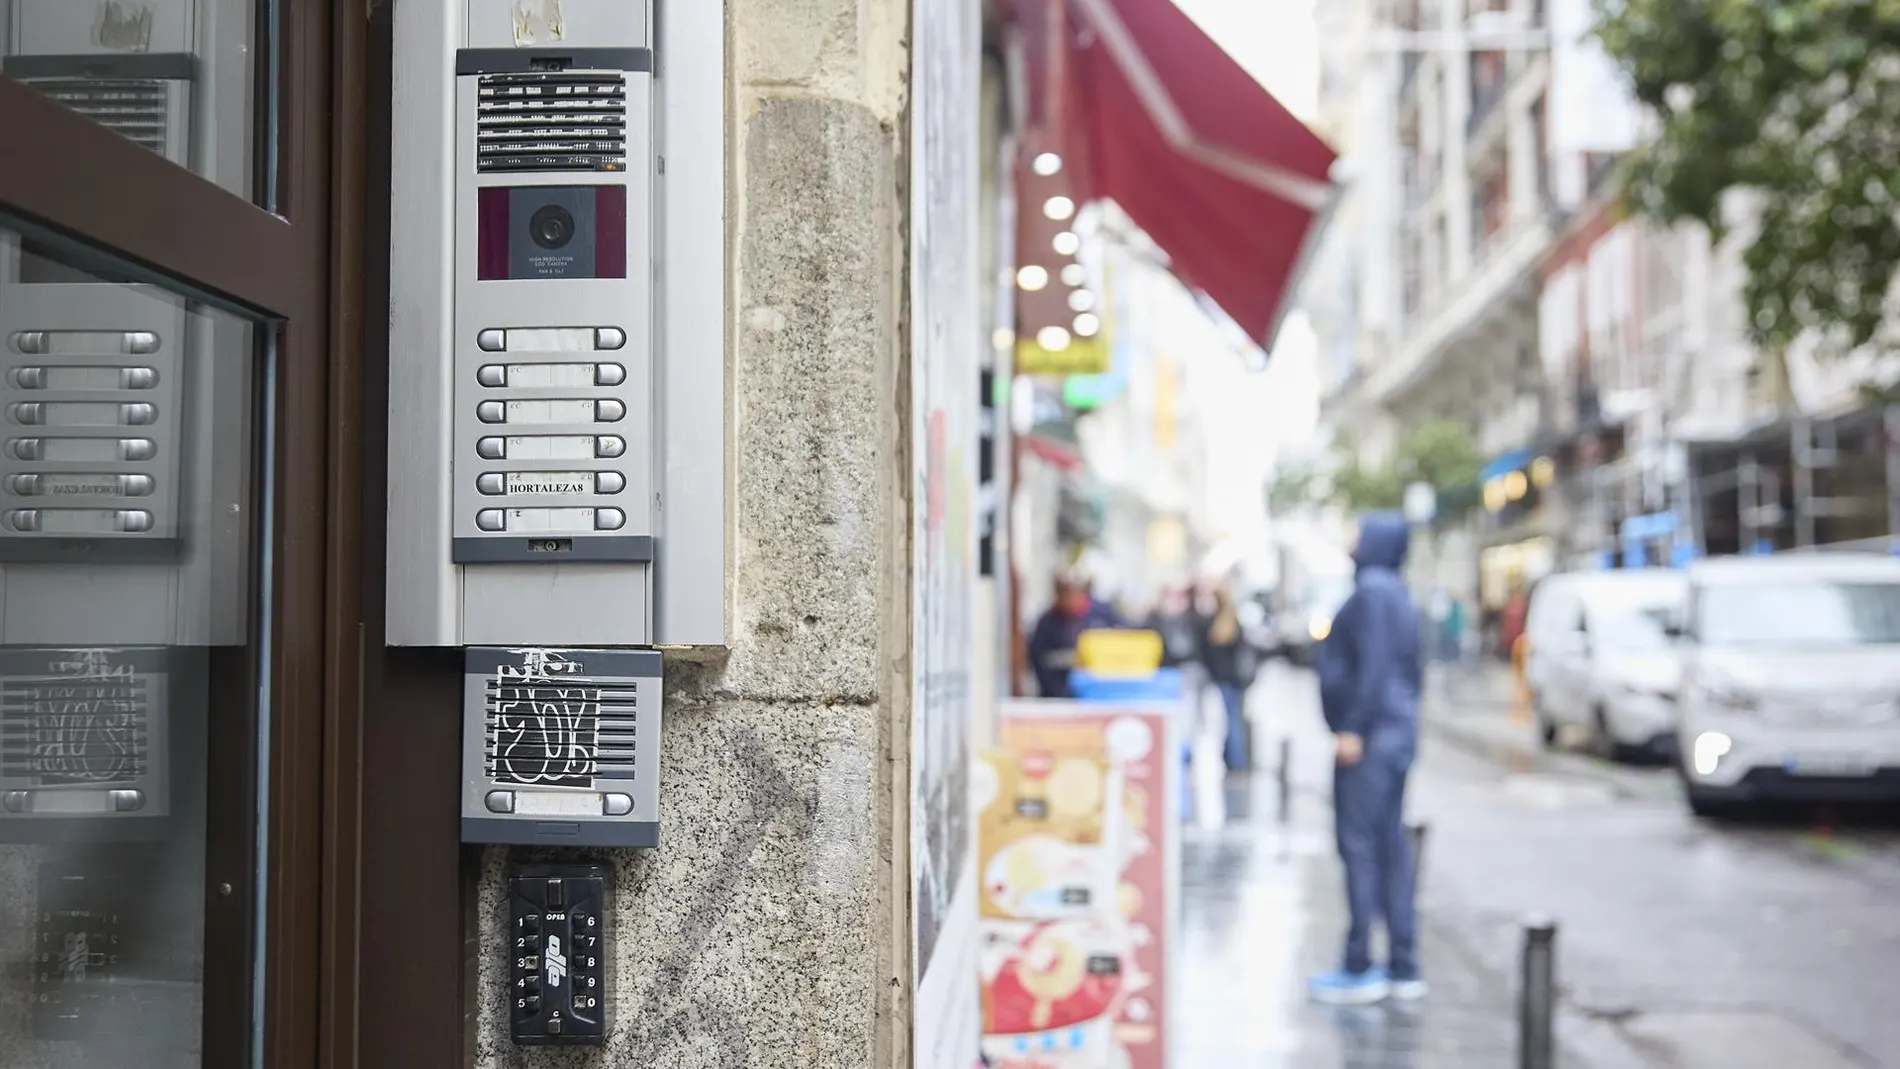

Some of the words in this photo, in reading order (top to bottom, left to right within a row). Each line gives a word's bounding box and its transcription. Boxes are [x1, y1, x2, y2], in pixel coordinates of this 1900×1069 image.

[519, 917, 523, 927] 1
[587, 916, 596, 926] 6
[517, 937, 525, 947] 2
[588, 937, 596, 947] 7
[517, 957, 525, 967] 3
[587, 957, 596, 967] 8
[517, 978, 525, 988] 4
[587, 977, 596, 987] 9
[518, 998, 525, 1008] 5
[587, 997, 596, 1007] 0
